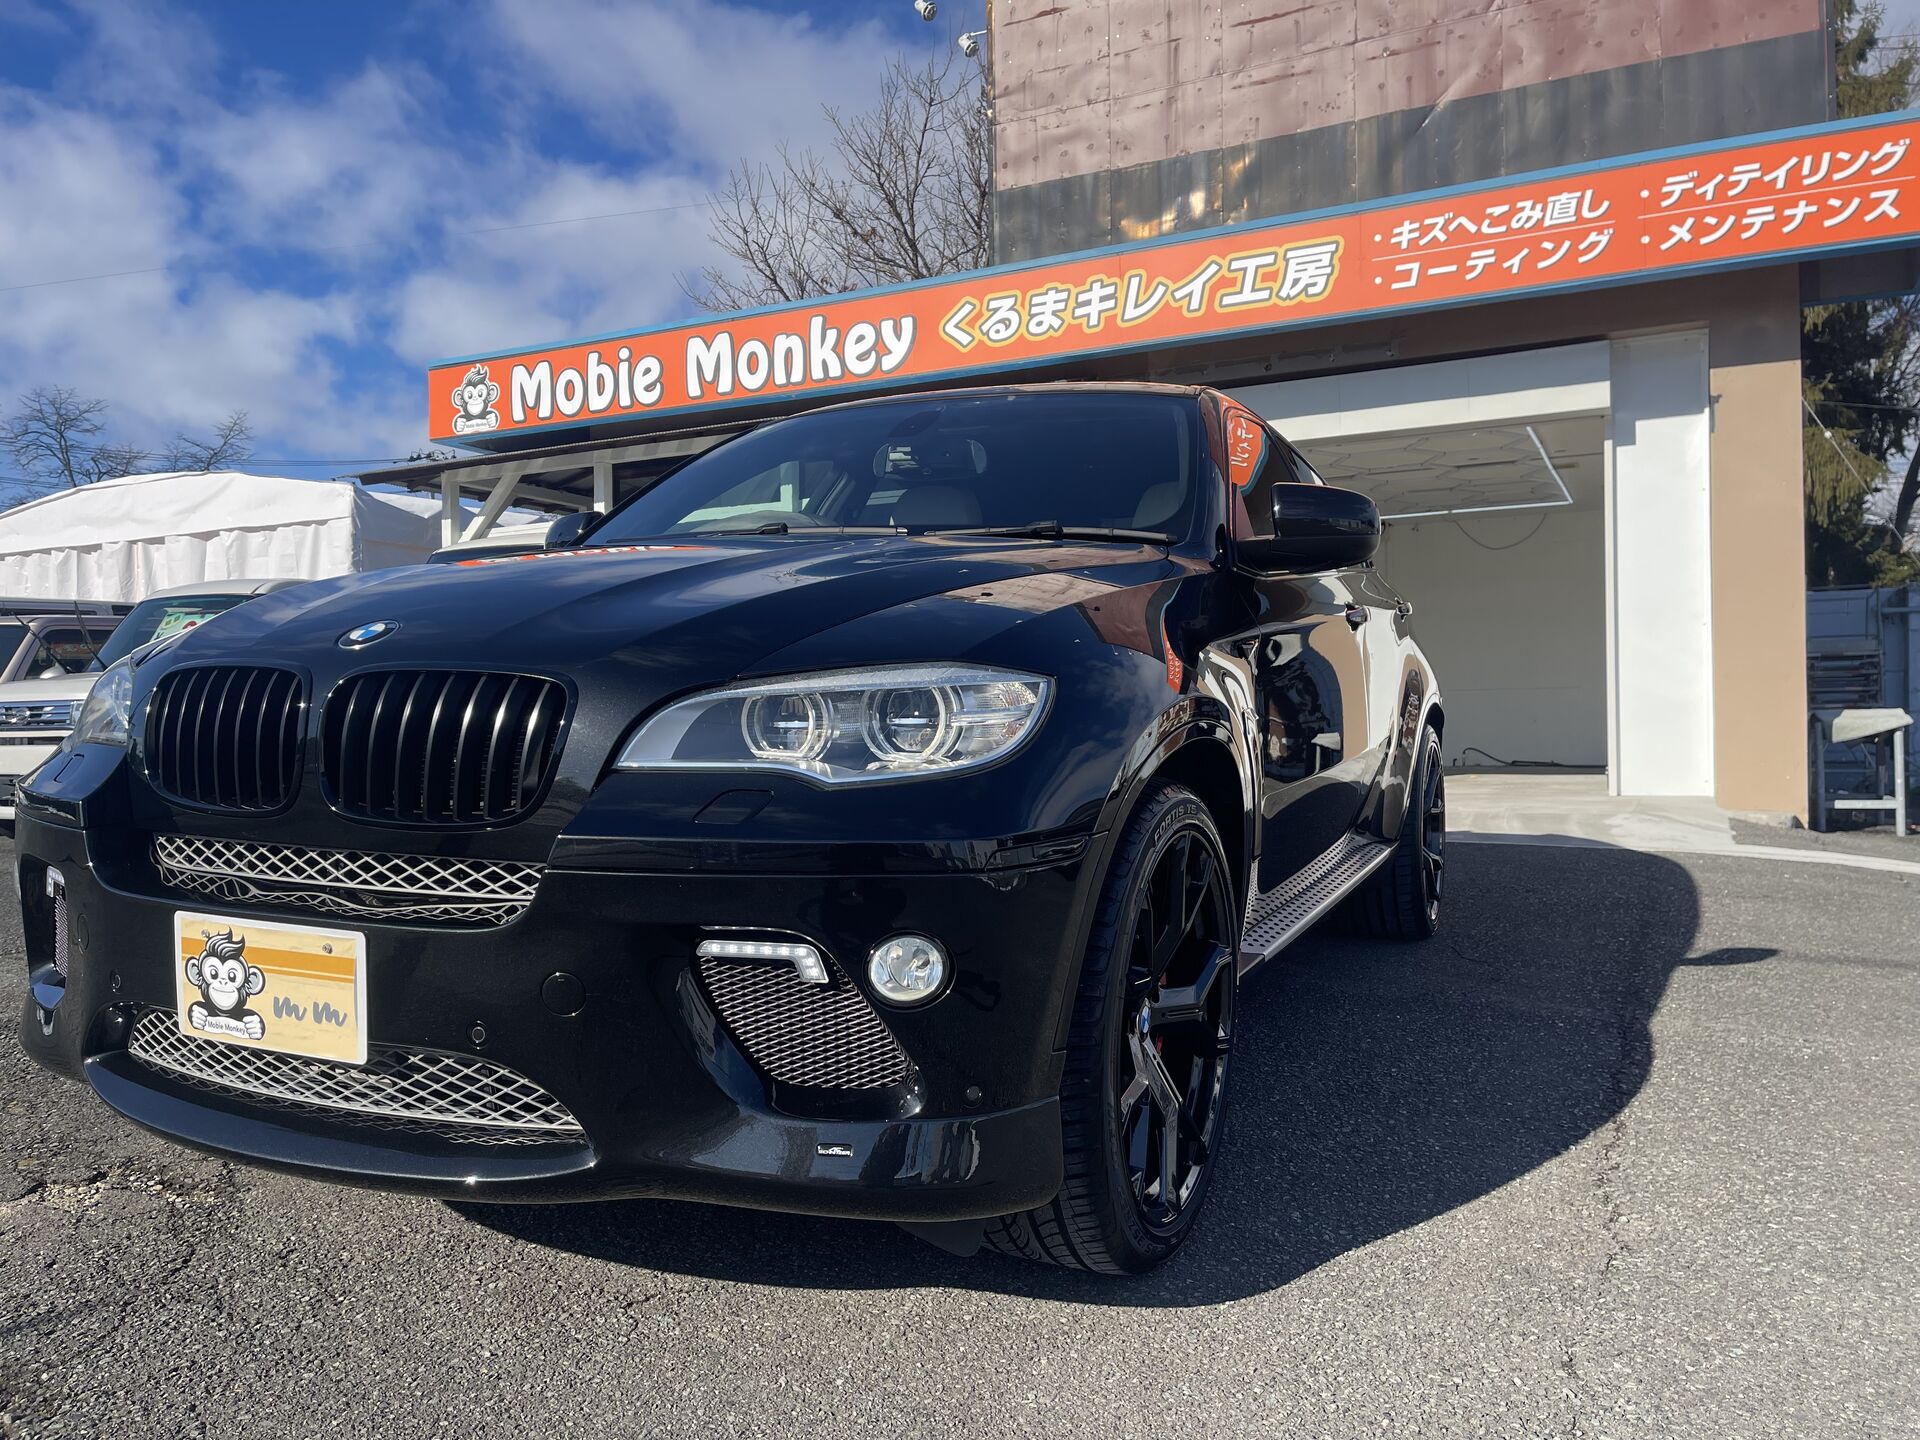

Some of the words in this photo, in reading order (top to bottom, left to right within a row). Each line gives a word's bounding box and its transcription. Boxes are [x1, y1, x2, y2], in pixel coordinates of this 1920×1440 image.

[1660, 188, 1901, 250] メンテナンス
[942, 240, 1341, 349] くるまキレイ工房
[511, 347, 662, 422] Mobie
[686, 314, 916, 399] Monkey
[207, 1020, 223, 1030] Mobie
[224, 1023, 245, 1035] Monkey
